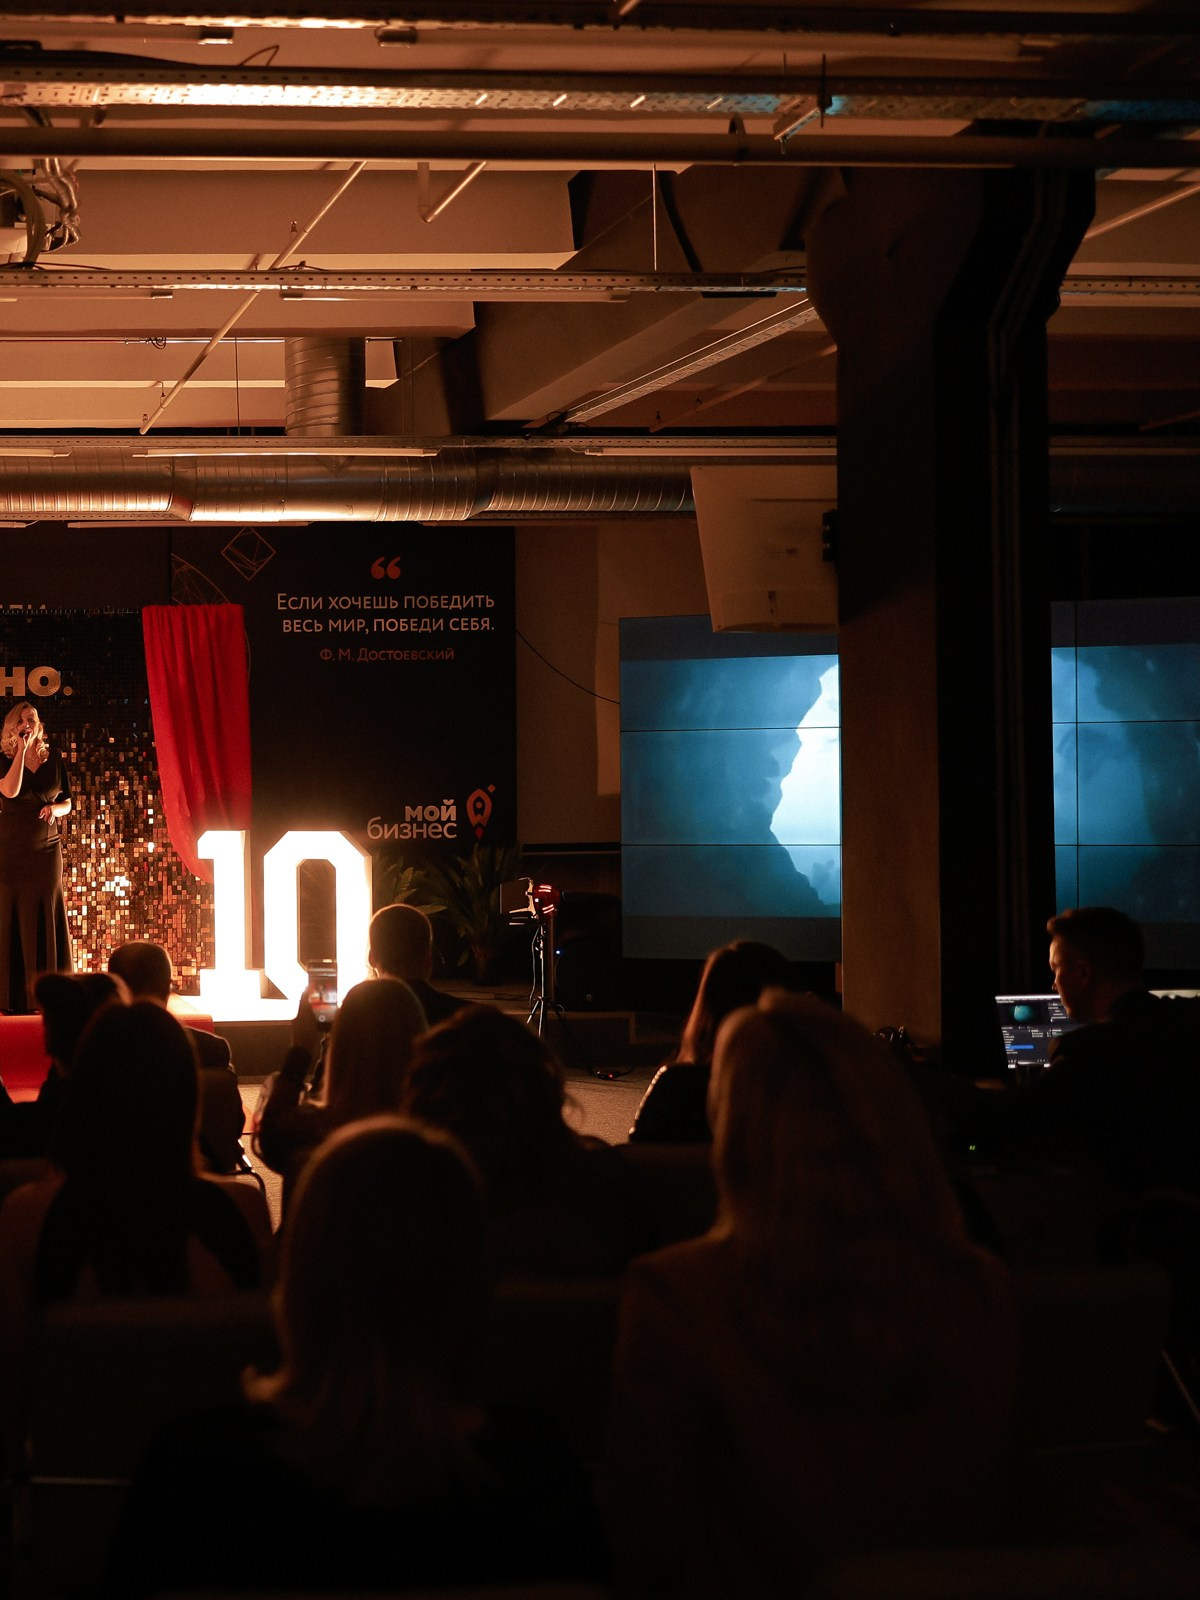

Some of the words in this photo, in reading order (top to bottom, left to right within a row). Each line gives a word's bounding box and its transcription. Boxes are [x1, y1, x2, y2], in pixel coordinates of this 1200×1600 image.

[282, 619, 323, 633] ВЕСЬ
[328, 618, 369, 635] МИР,
[373, 618, 444, 633] ПОБЕДИ
[449, 617, 495, 631] СЕБЯ.
[319, 648, 336, 661] Ф.
[338, 648, 353, 661] М.
[404, 799, 457, 822] мой
[366, 816, 458, 840] бизнес
[197, 830, 372, 1002] 10
